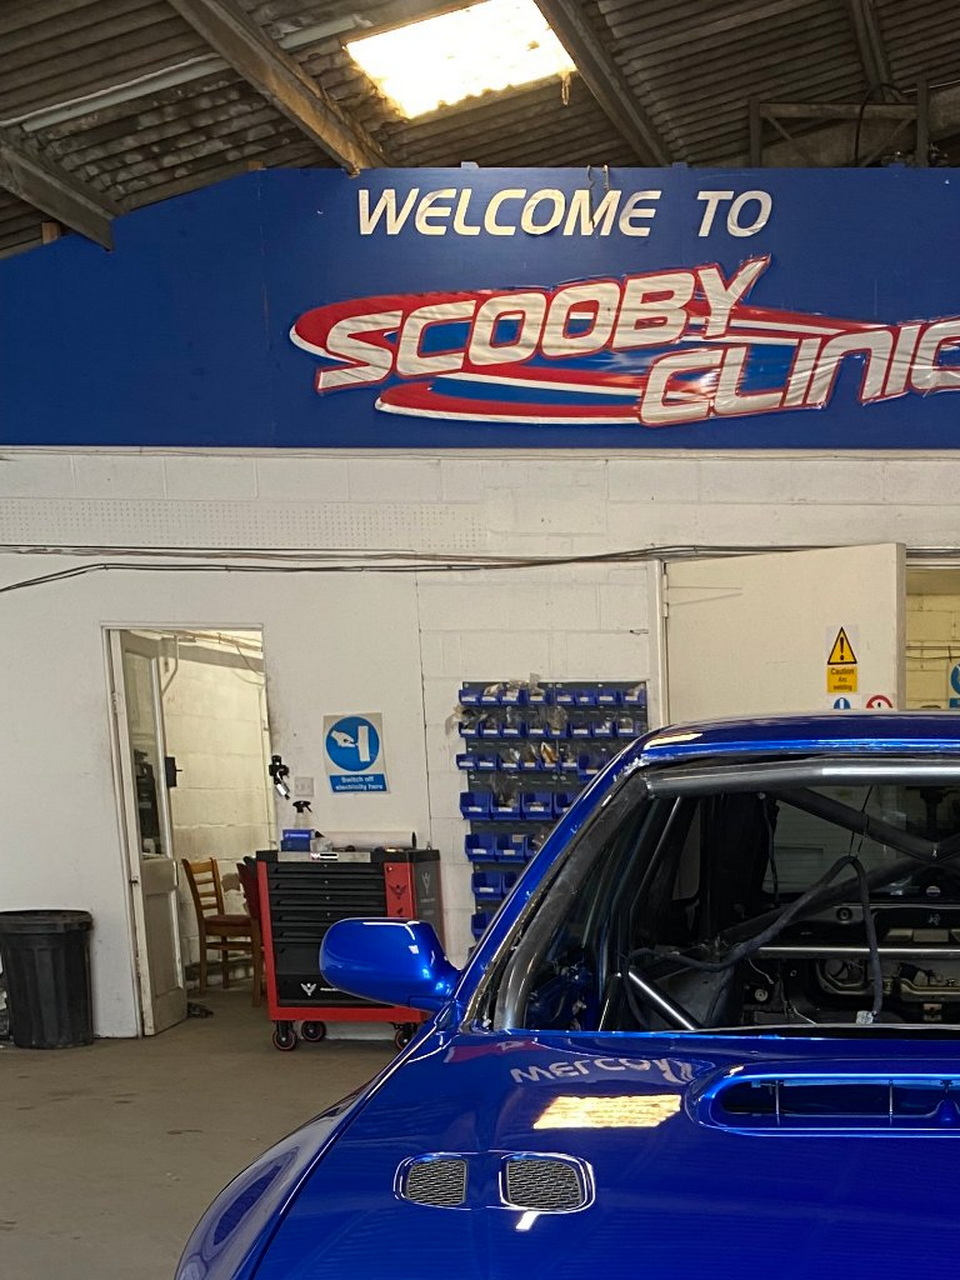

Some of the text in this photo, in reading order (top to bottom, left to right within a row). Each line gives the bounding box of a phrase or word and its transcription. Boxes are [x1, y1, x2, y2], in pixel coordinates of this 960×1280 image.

[358, 188, 773, 237] WELCOME TO
[317, 256, 771, 392] SCOOBY
